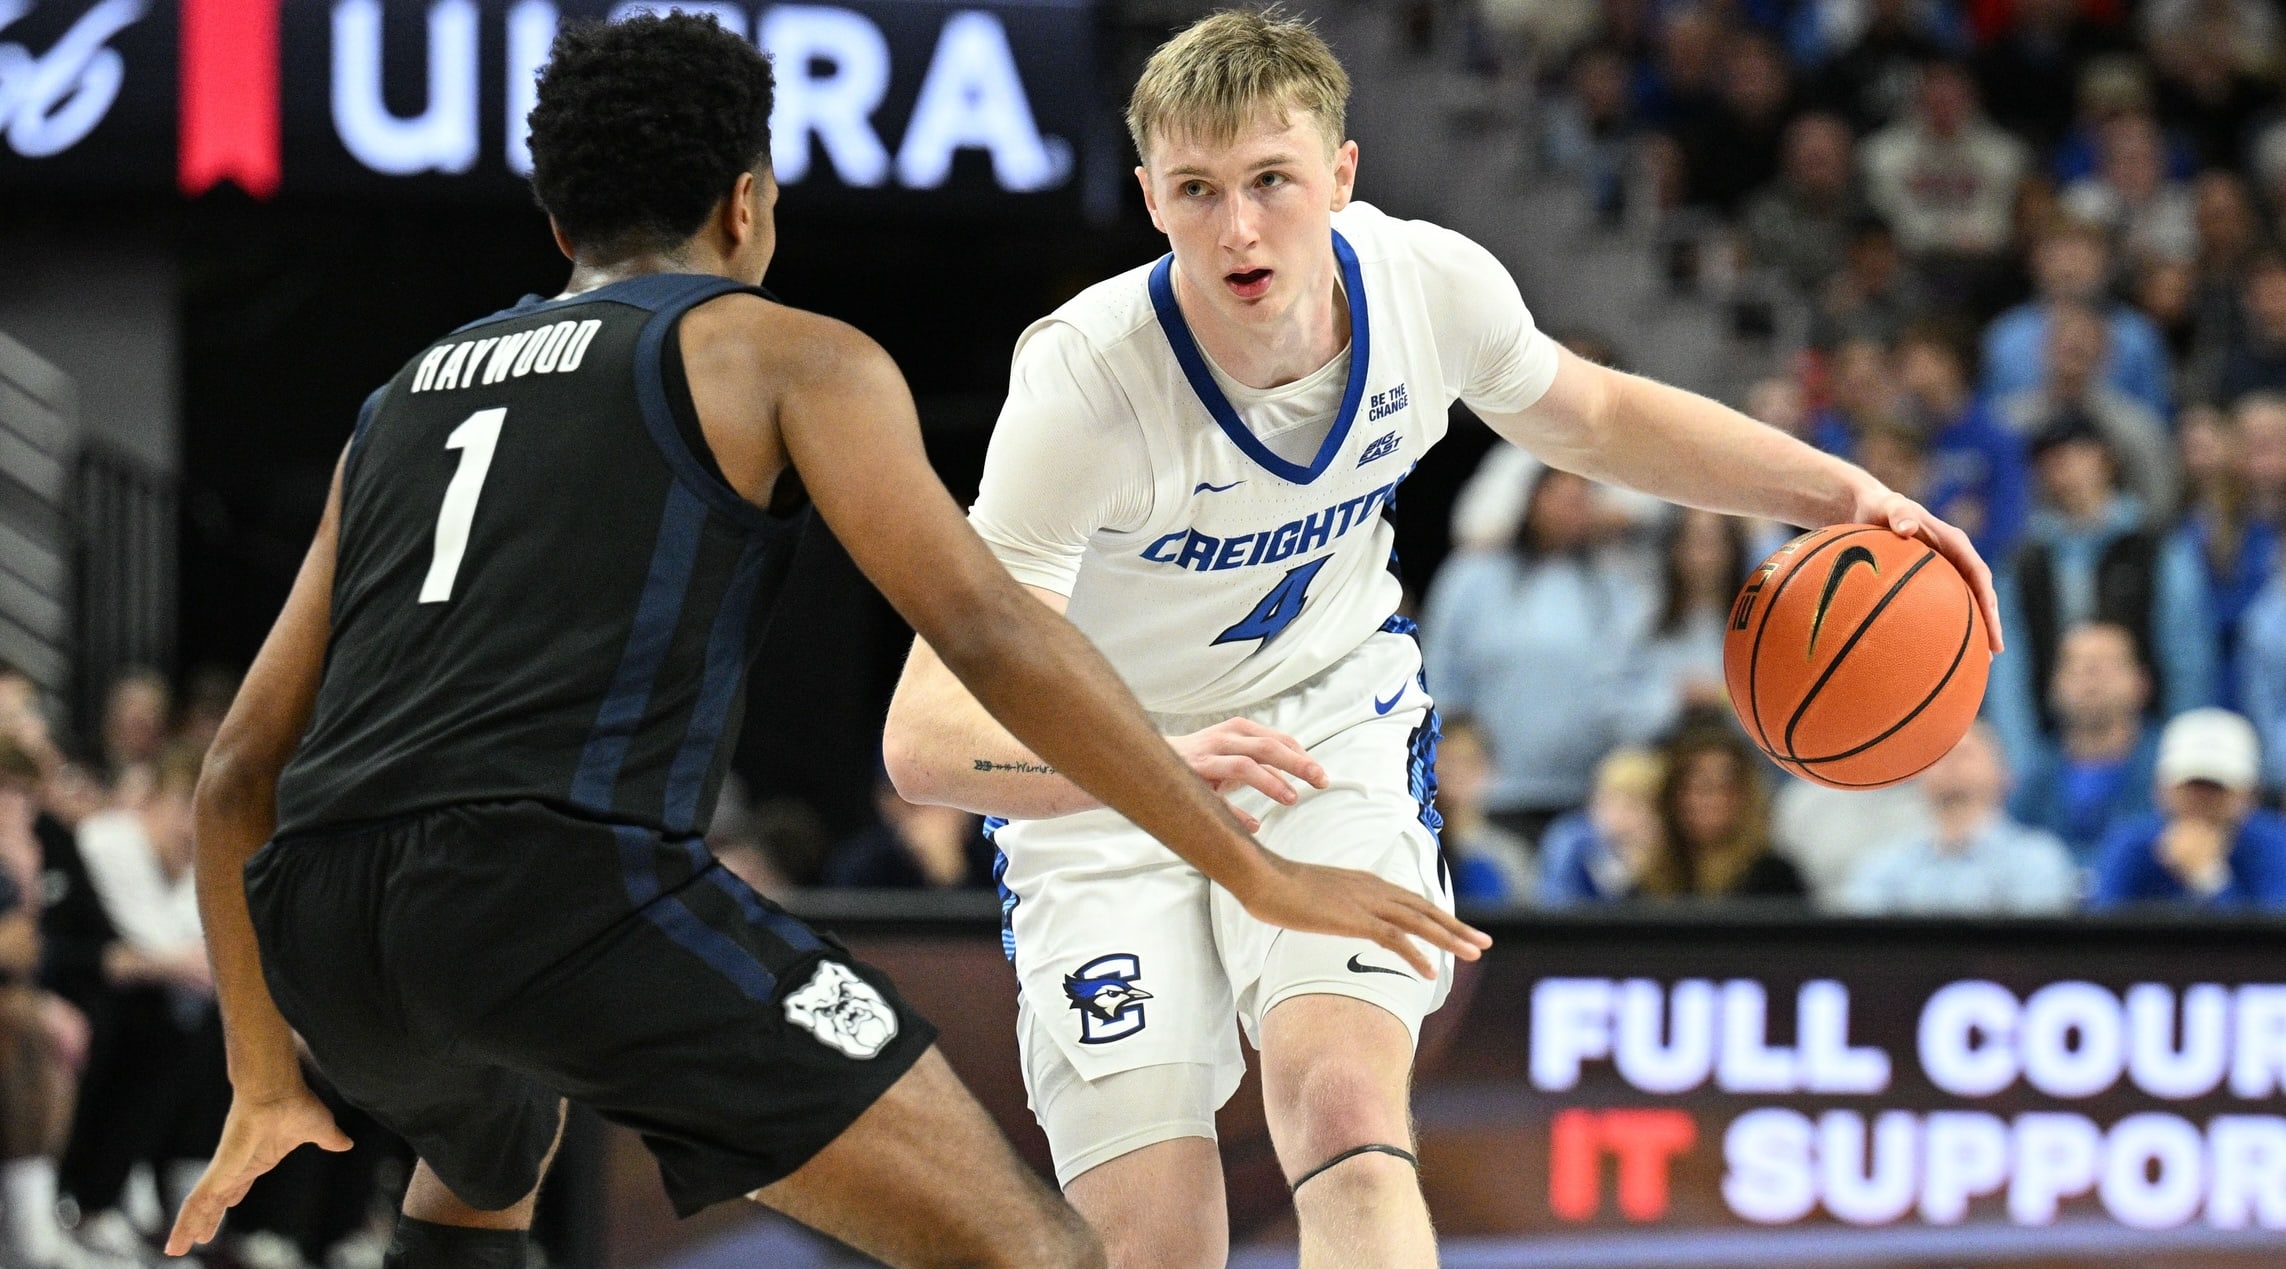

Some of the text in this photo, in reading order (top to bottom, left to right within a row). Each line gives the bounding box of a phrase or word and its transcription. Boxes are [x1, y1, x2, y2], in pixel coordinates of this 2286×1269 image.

[331, 0, 1047, 192] URA
[411, 319, 602, 393] HAYWOOD
[1371, 383, 1405, 408] BE THE
[1358, 436, 1403, 463] EAST
[1364, 430, 1396, 453] BIG
[1369, 395, 1408, 421] CHANGE
[418, 407, 507, 603] 1
[1209, 552, 1336, 655] 4
[1529, 977, 2286, 1099] FULL COUR
[1549, 1106, 2286, 1230] IT SUPPOR
